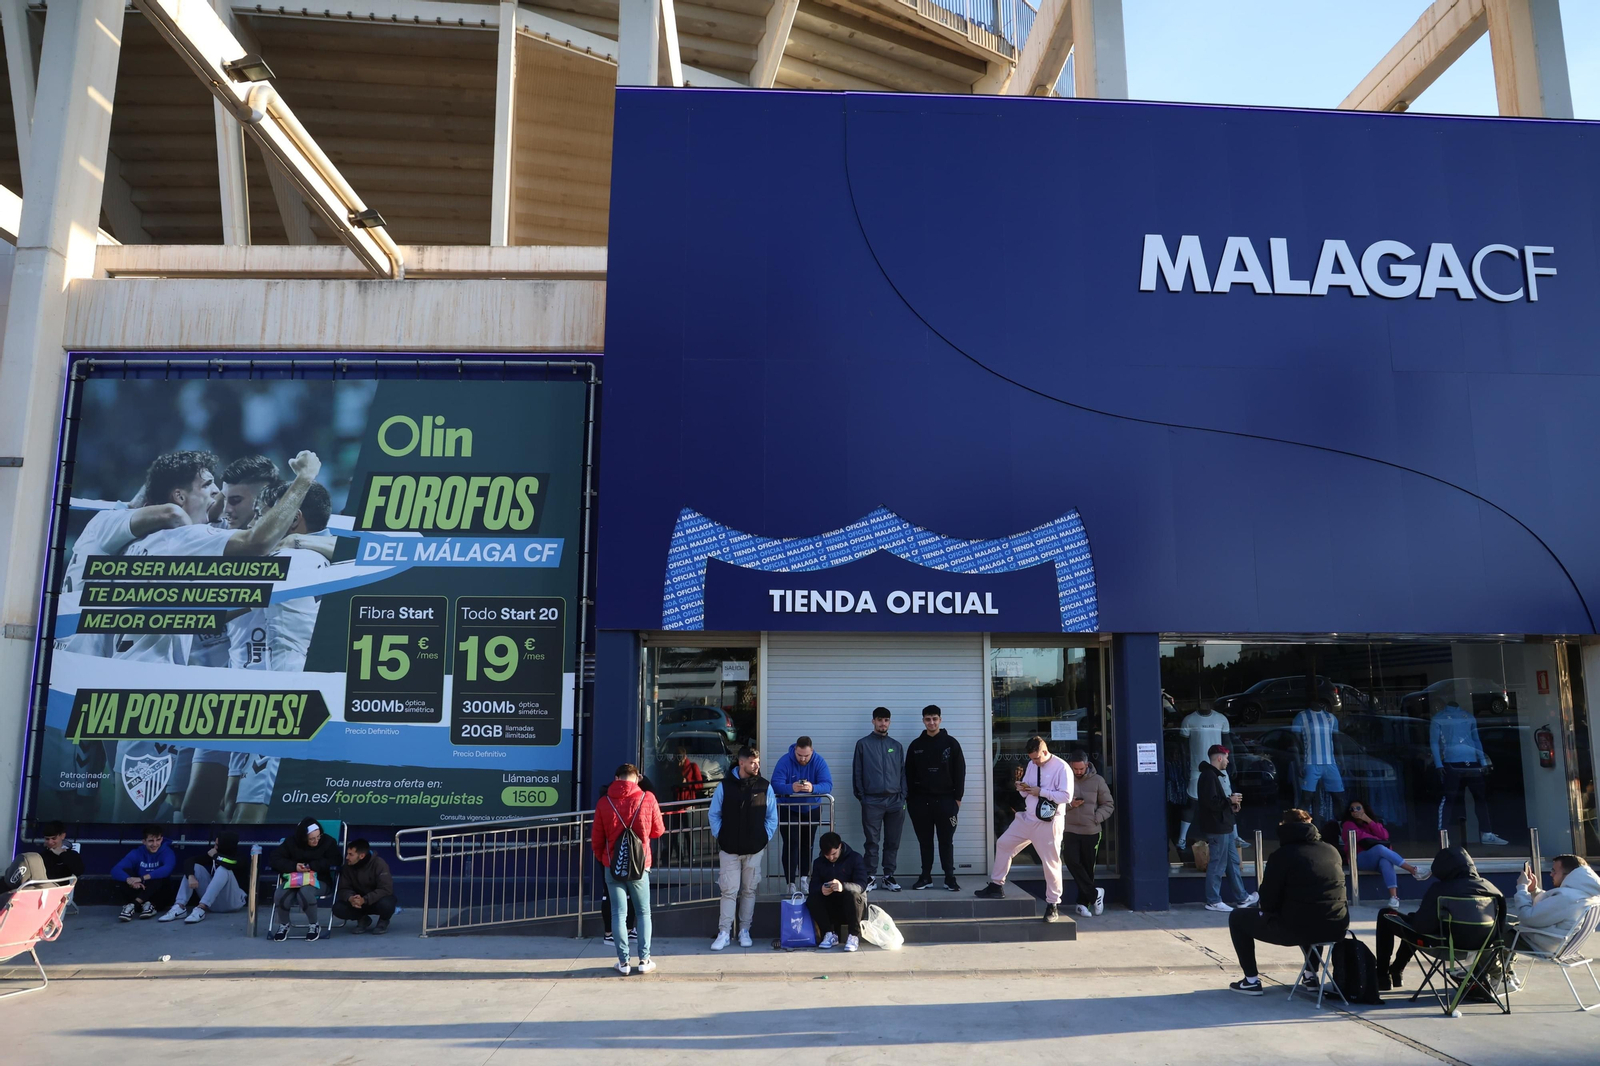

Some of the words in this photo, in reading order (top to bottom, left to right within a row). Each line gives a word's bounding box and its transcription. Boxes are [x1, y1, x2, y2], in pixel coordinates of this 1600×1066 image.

[378, 415, 473, 457] Olin
[362, 475, 539, 530] FOROFOS
[1054, 514, 1081, 526] MALAGA
[685, 523, 714, 536] MALAGA
[687, 530, 716, 542] MALAGA
[689, 536, 718, 549] MALAGA
[691, 543, 720, 556] MALAGA
[729, 533, 752, 544] TIENDA
[736, 553, 758, 564] TIENDA
[759, 546, 784, 557] OFICIAL
[784, 537, 812, 550] MALAGA
[822, 528, 844, 538] TIENDA
[845, 520, 869, 531] OFICIAL
[869, 512, 897, 524] MALAGA
[761, 552, 786, 564] OFICIAL
[786, 544, 814, 556] MALAGA
[824, 534, 846, 545] TIENDA
[847, 527, 871, 538] OFICIAL
[872, 518, 899, 530] MALAGA
[918, 535, 940, 546] TIENDA
[363, 542, 408, 561] DEL
[414, 538, 517, 562] MÁLAGA
[524, 544, 558, 562] CF
[734, 547, 756, 558] TIENDA
[757, 539, 781, 550] OFICIAL
[764, 559, 788, 570] OFICIAL
[789, 550, 817, 563] MALAGA
[826, 541, 848, 552] TIENDA
[849, 533, 873, 545] OFICIAL
[874, 525, 901, 537] MALAGA
[791, 557, 819, 570] MALAGA
[828, 547, 851, 558] TIENDA
[851, 540, 875, 551] OFICIAL
[876, 531, 904, 544] MALAGA
[920, 542, 942, 552] TIENDA
[922, 548, 944, 559] TIENDA
[945, 541, 968, 552] OFICIAL
[924, 555, 946, 566] TIENDA
[947, 547, 971, 558] OFICIAL
[971, 539, 999, 551] MALAGA
[950, 554, 973, 565] OFICIAL
[974, 545, 1001, 558] MALAGA
[1010, 536, 1032, 546] TIENDA
[1032, 528, 1056, 540] OFICIAL
[952, 560, 976, 572] OFICIAL
[976, 552, 1004, 564] MALAGA
[1013, 542, 1034, 553] TIENDA
[1035, 535, 1058, 546] OFICIAL
[1059, 526, 1086, 539] MALAGA
[668, 558, 692, 570] OFICIAL
[732, 540, 754, 551] TIENDA
[830, 554, 853, 565] TIENDA
[979, 558, 1006, 571] MALAGA
[1015, 549, 1037, 560] TIENDA
[1037, 542, 1061, 553] OFICIAL
[1017, 555, 1039, 566] TIENDA
[1040, 548, 1063, 559] OFICIAL
[89, 562, 127, 576] POR
[131, 562, 165, 576] SER
[168, 562, 285, 579] MALAGUISTA,
[670, 565, 695, 577] OFICIAL
[672, 572, 697, 583] OFICIAL
[674, 578, 699, 590] OFICIAL
[88, 588, 107, 601] TE
[111, 588, 178, 602] DAMOS
[181, 588, 262, 602] NUESTRA
[676, 585, 701, 597] OFICIAL
[678, 592, 703, 604] OFICIAL
[769, 590, 877, 613] TIENDA
[887, 591, 998, 614] OFICIAL
[359, 607, 395, 619] Fibra
[399, 607, 434, 619] Start
[1060, 601, 1083, 612] OFICIAL
[461, 607, 497, 620] Todo
[500, 608, 536, 620] Start
[539, 608, 558, 620] 20
[1062, 608, 1086, 619] OFICIAL
[1064, 614, 1088, 626] OFICIAL
[84, 614, 146, 628] MEJOR
[148, 614, 216, 629] OFERTA
[353, 634, 410, 681] 15
[418, 637, 429, 649] €
[416, 652, 438, 660] /mes
[459, 636, 519, 681] 19
[524, 638, 536, 650] €
[523, 652, 545, 661] /mes
[351, 700, 404, 712] 300Mb
[462, 701, 515, 714] 300Mb
[120, 693, 178, 734] POR
[179, 694, 308, 735] USTEDES!
[461, 725, 503, 738] 20GB
[325, 778, 350, 787] Toda
[352, 779, 391, 787] nuestra
[394, 779, 424, 788] oferta
[503, 774, 549, 783] Llámanos
[551, 774, 559, 783] al
[513, 790, 547, 803] 1560
